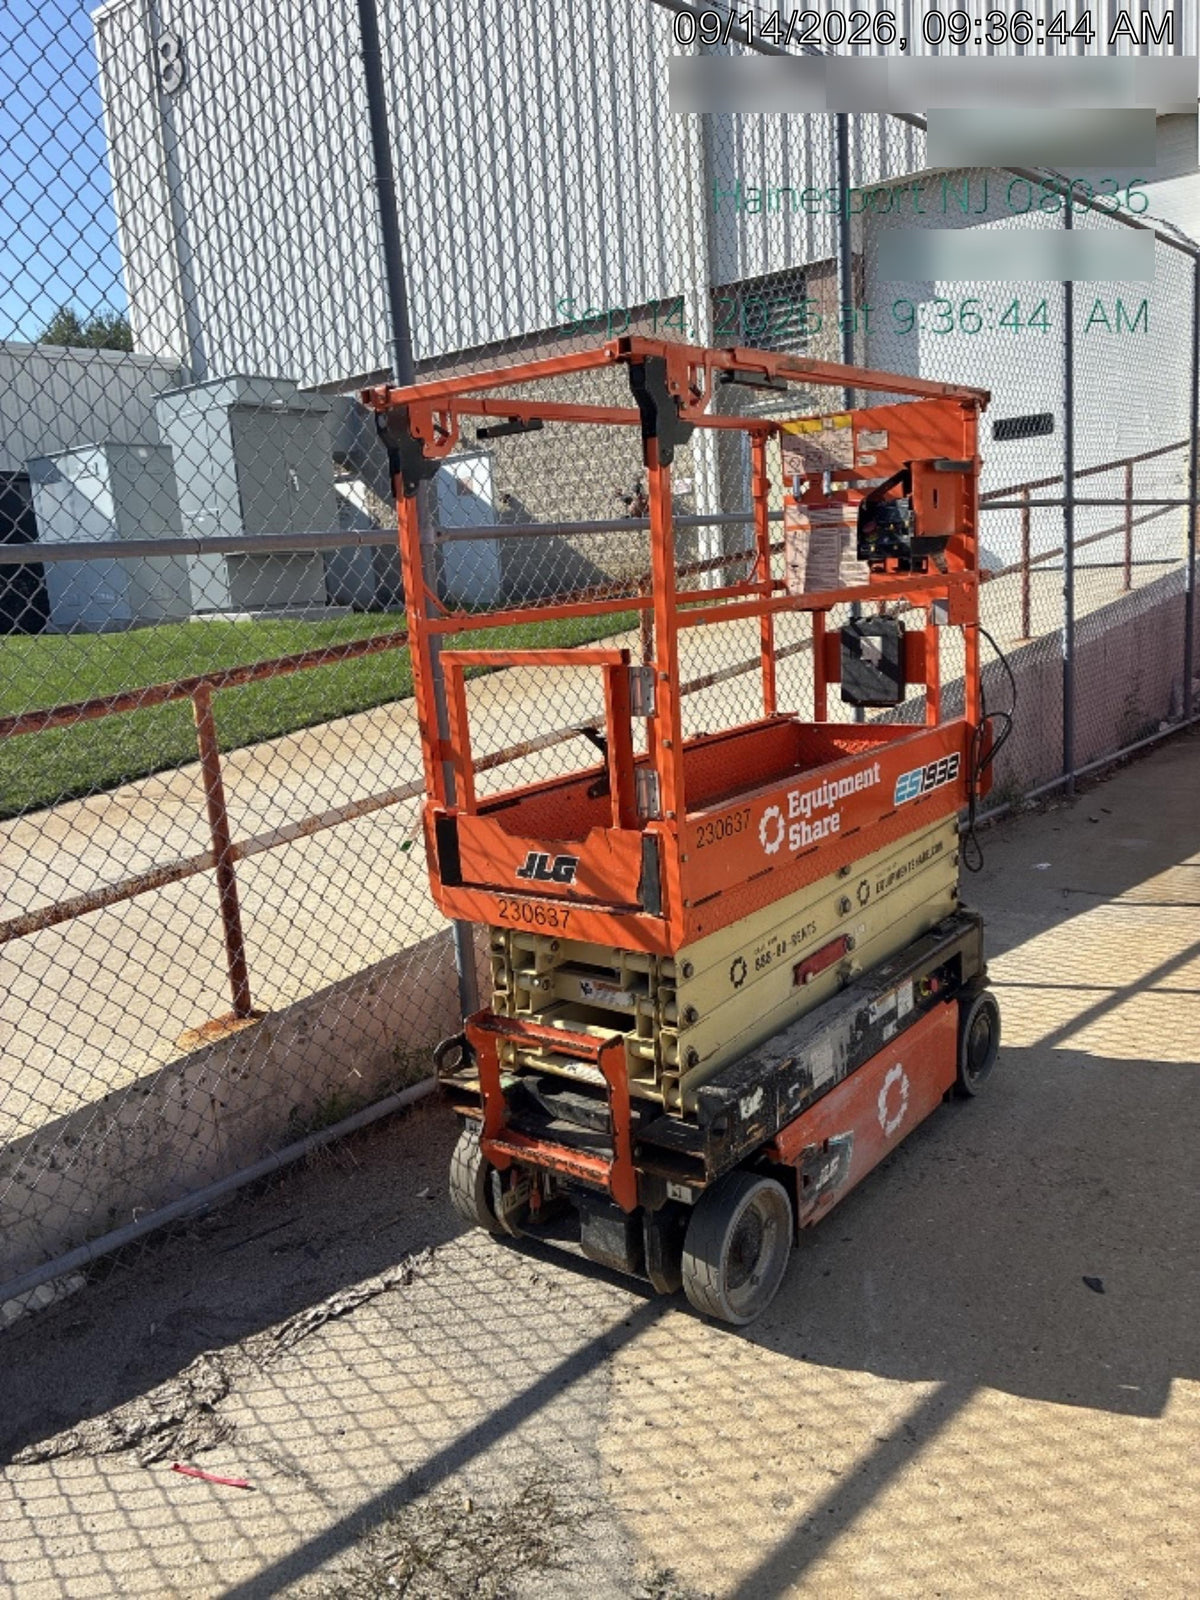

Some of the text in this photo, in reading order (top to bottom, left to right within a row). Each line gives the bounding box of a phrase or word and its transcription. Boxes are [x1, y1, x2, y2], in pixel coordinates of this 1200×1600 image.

[156, 31, 185, 96] 8
[787, 762, 881, 818] Equipment
[894, 751, 961, 807] ES1932
[696, 808, 751, 849] 230637
[788, 812, 841, 851] Share
[515, 851, 580, 886] JLG
[498, 899, 570, 929] 230637
